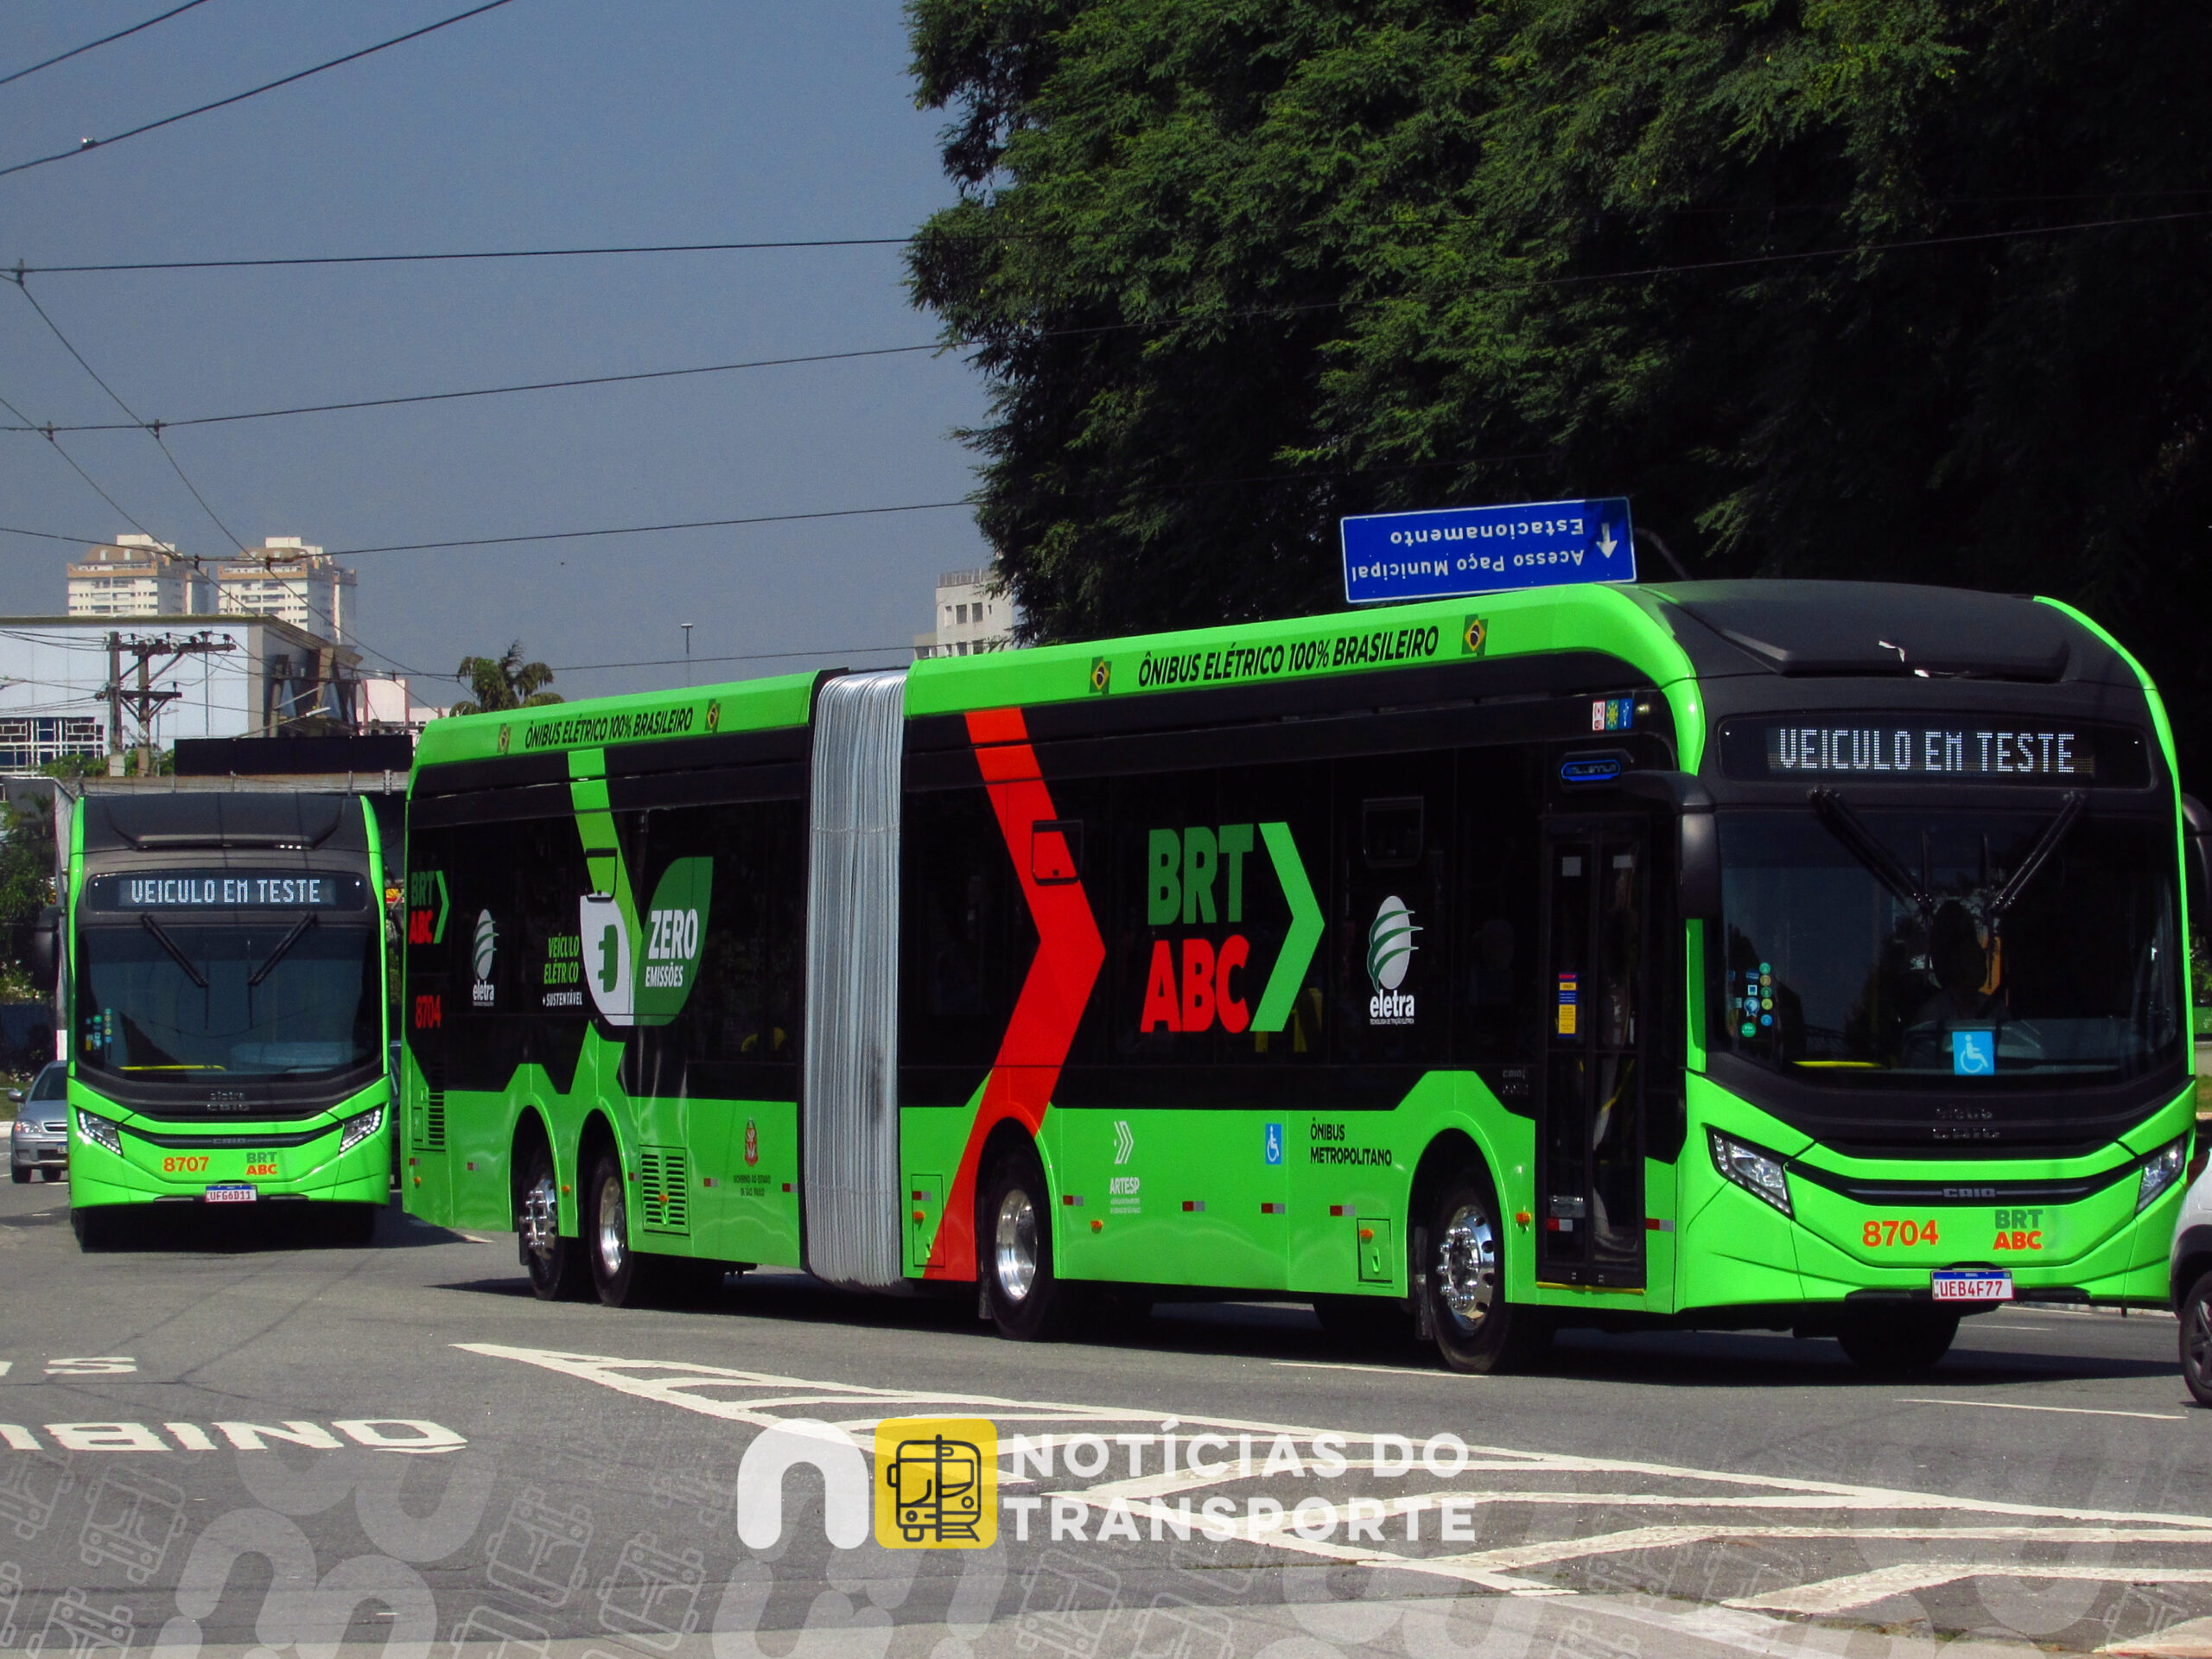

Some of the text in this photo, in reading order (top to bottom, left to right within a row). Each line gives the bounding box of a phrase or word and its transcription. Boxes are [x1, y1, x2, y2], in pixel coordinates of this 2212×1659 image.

[1390, 518, 1584, 547] Estacionamento
[1352, 549, 1585, 582] Acesso Paço Municipal
[1138, 625, 1440, 688] ÔNIBUS ELÉTRICO 100% BRASILEIRO
[524, 706, 694, 749] ÔNIBUS ELÉTRICO 100% BRASILEIRO
[1779, 728, 2075, 773] VEICULO EM TESTE
[1147, 823, 1255, 925] BRT
[130, 878, 321, 904] VEICULO EM TESTE
[410, 870, 435, 907] BRT
[409, 910, 435, 944] ABC
[647, 908, 699, 960] ZERO
[548, 932, 580, 958] VEÍCULO
[543, 959, 579, 985] ELÉTRICO
[645, 962, 684, 988] EMISSÕES
[1140, 933, 1250, 1034] ABC
[472, 979, 495, 1001] eletra
[1370, 988, 1415, 1018] eletra
[415, 995, 442, 1029] 8704
[1310, 1116, 1346, 1141] ÔNIBUS
[162, 1156, 210, 1173] 8707
[245, 1151, 278, 1164] BRT
[1309, 1146, 1392, 1167] METROPOLITANO
[245, 1164, 278, 1176] ABC
[1109, 1176, 1141, 1195] ARTESP
[1994, 1209, 2044, 1230] BRT
[1862, 1219, 1940, 1248] 8704
[1993, 1230, 2043, 1251] ABC
[1940, 1280, 2003, 1297] UEB4F77
